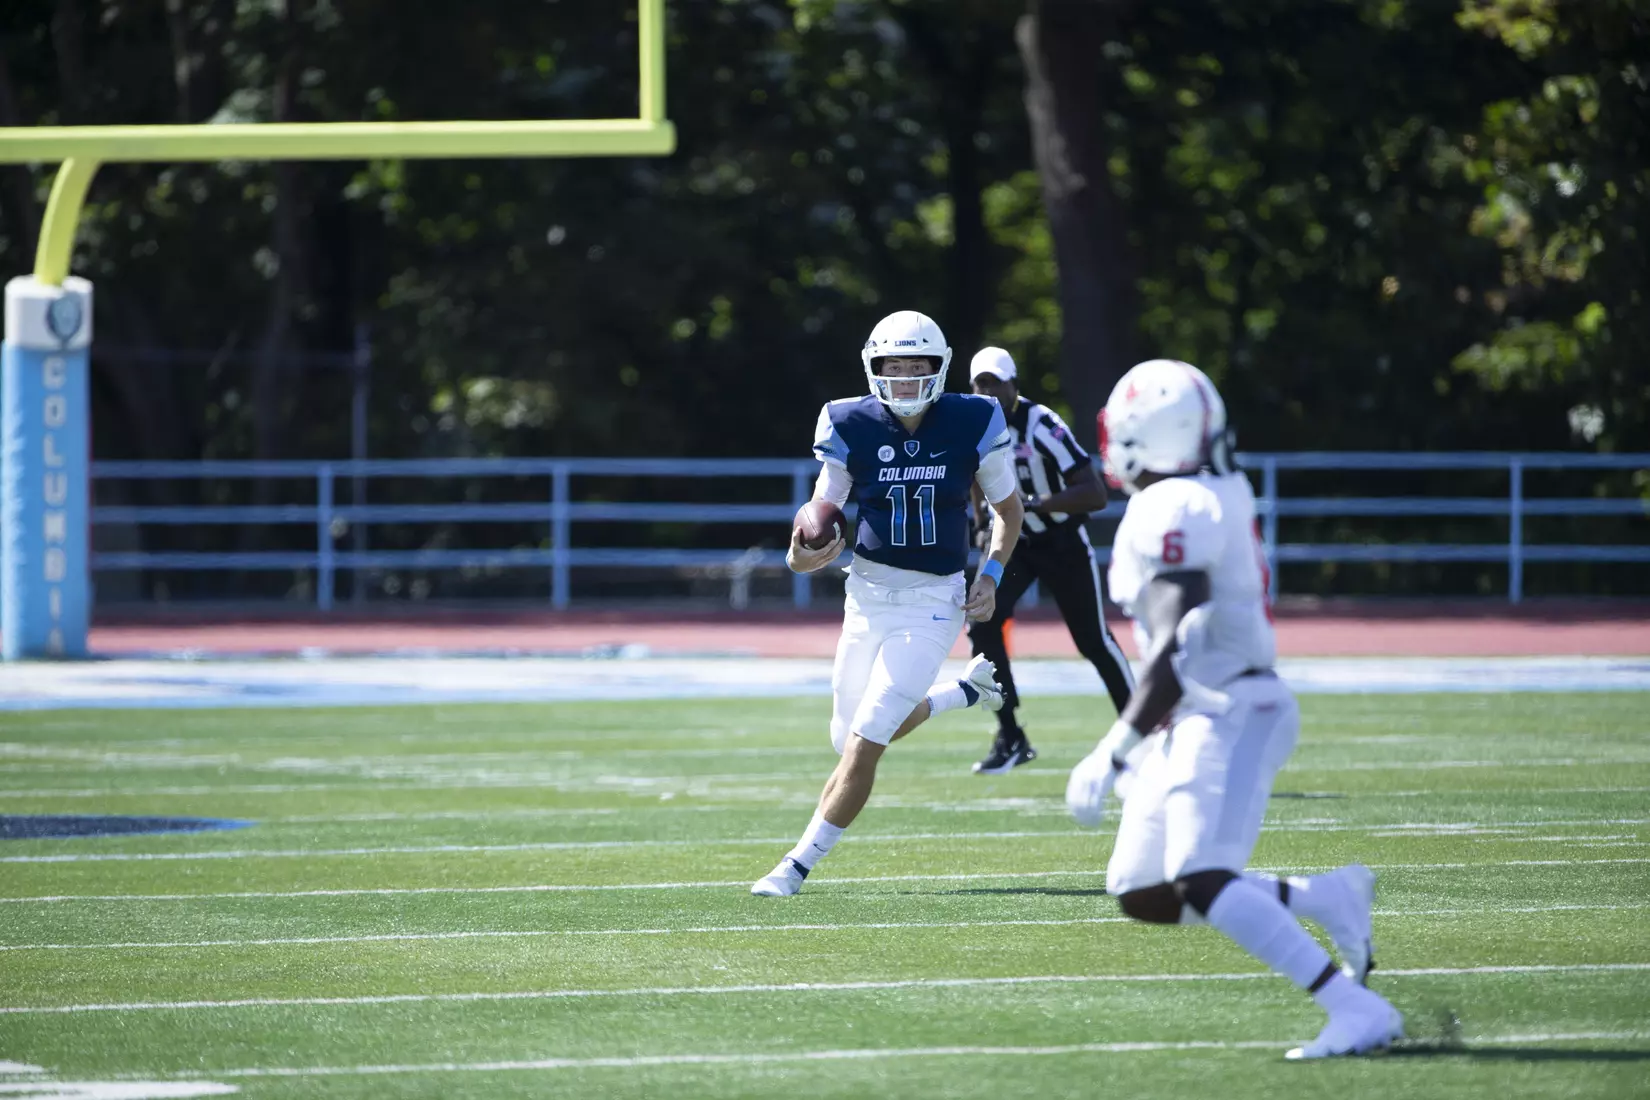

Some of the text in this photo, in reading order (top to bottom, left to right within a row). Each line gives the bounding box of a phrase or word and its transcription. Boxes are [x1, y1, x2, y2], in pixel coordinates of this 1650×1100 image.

[878, 465, 947, 482] COLUMBIA
[885, 484, 937, 546] 11
[1162, 530, 1185, 565] 6
